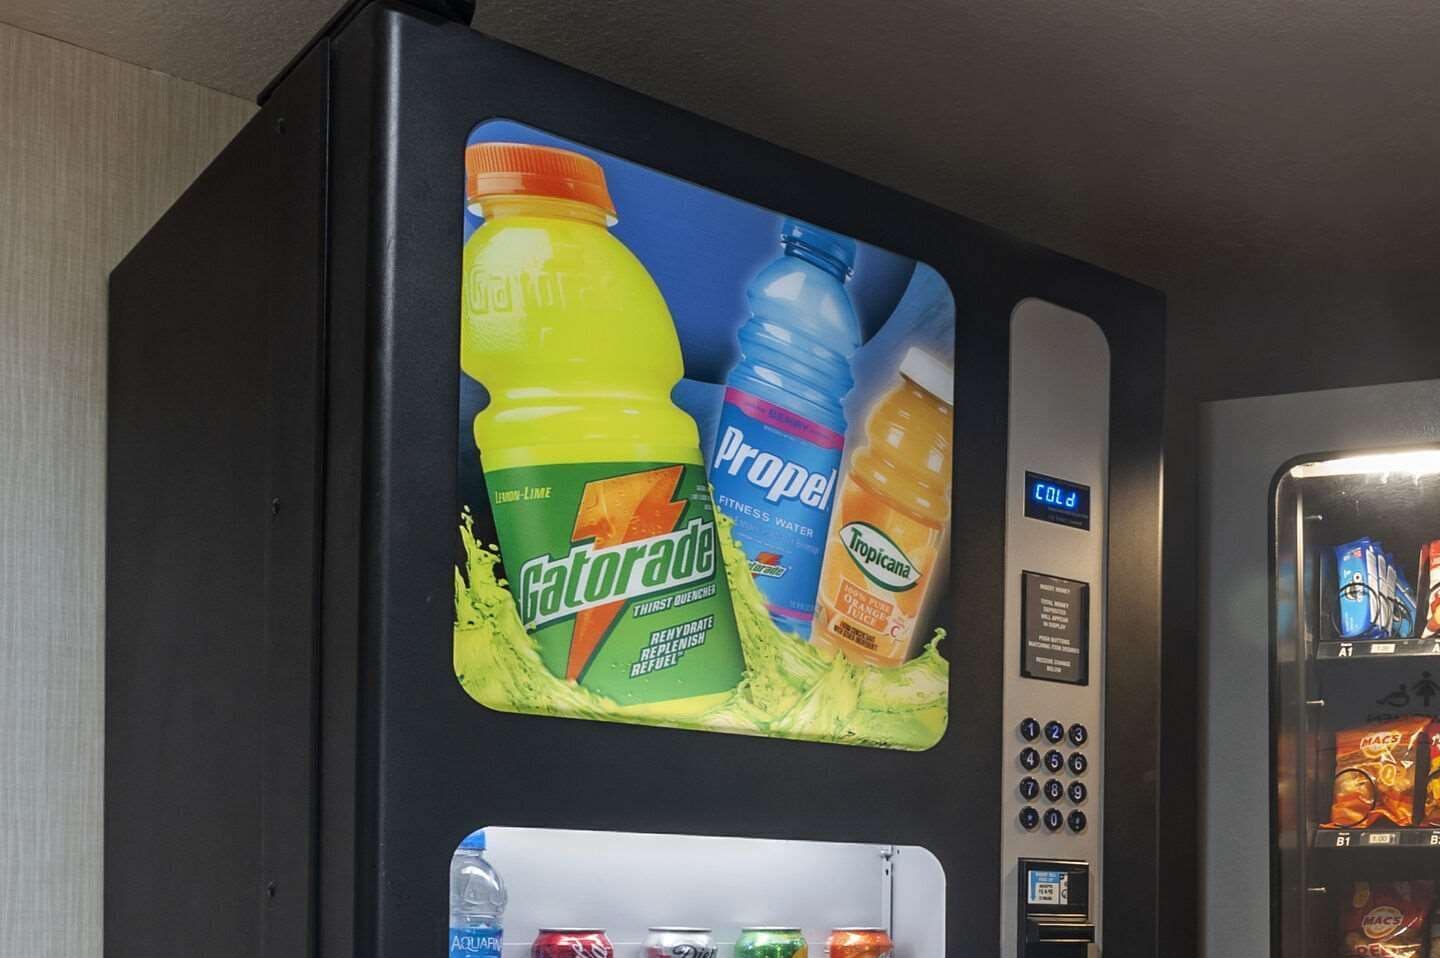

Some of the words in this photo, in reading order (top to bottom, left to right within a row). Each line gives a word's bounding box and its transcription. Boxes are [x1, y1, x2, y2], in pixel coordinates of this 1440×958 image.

[714, 425, 837, 510] Propel
[719, 495, 770, 522] FITNESS
[775, 517, 814, 538] WATER
[850, 526, 911, 579] Tropicana
[521, 523, 715, 627] Gatorade
[633, 598, 673, 617] THIRST
[674, 585, 716, 607] QUENCHER
[651, 616, 713, 643] REHYDRATE
[641, 632, 705, 661] REPLENISH
[1339, 647, 1353, 657] A1
[1028, 723, 1034, 737] 1
[1051, 725, 1059, 739] 2
[1075, 728, 1083, 742] 3
[1026, 752, 1034, 766] 4
[1050, 754, 1059, 768] 5
[1074, 756, 1083, 770] 6
[1027, 782, 1034, 796] 7
[1051, 783, 1059, 797] 8
[1074, 785, 1082, 800] 9
[1050, 812, 1058, 827] 0
[1336, 837, 1351, 846] B1
